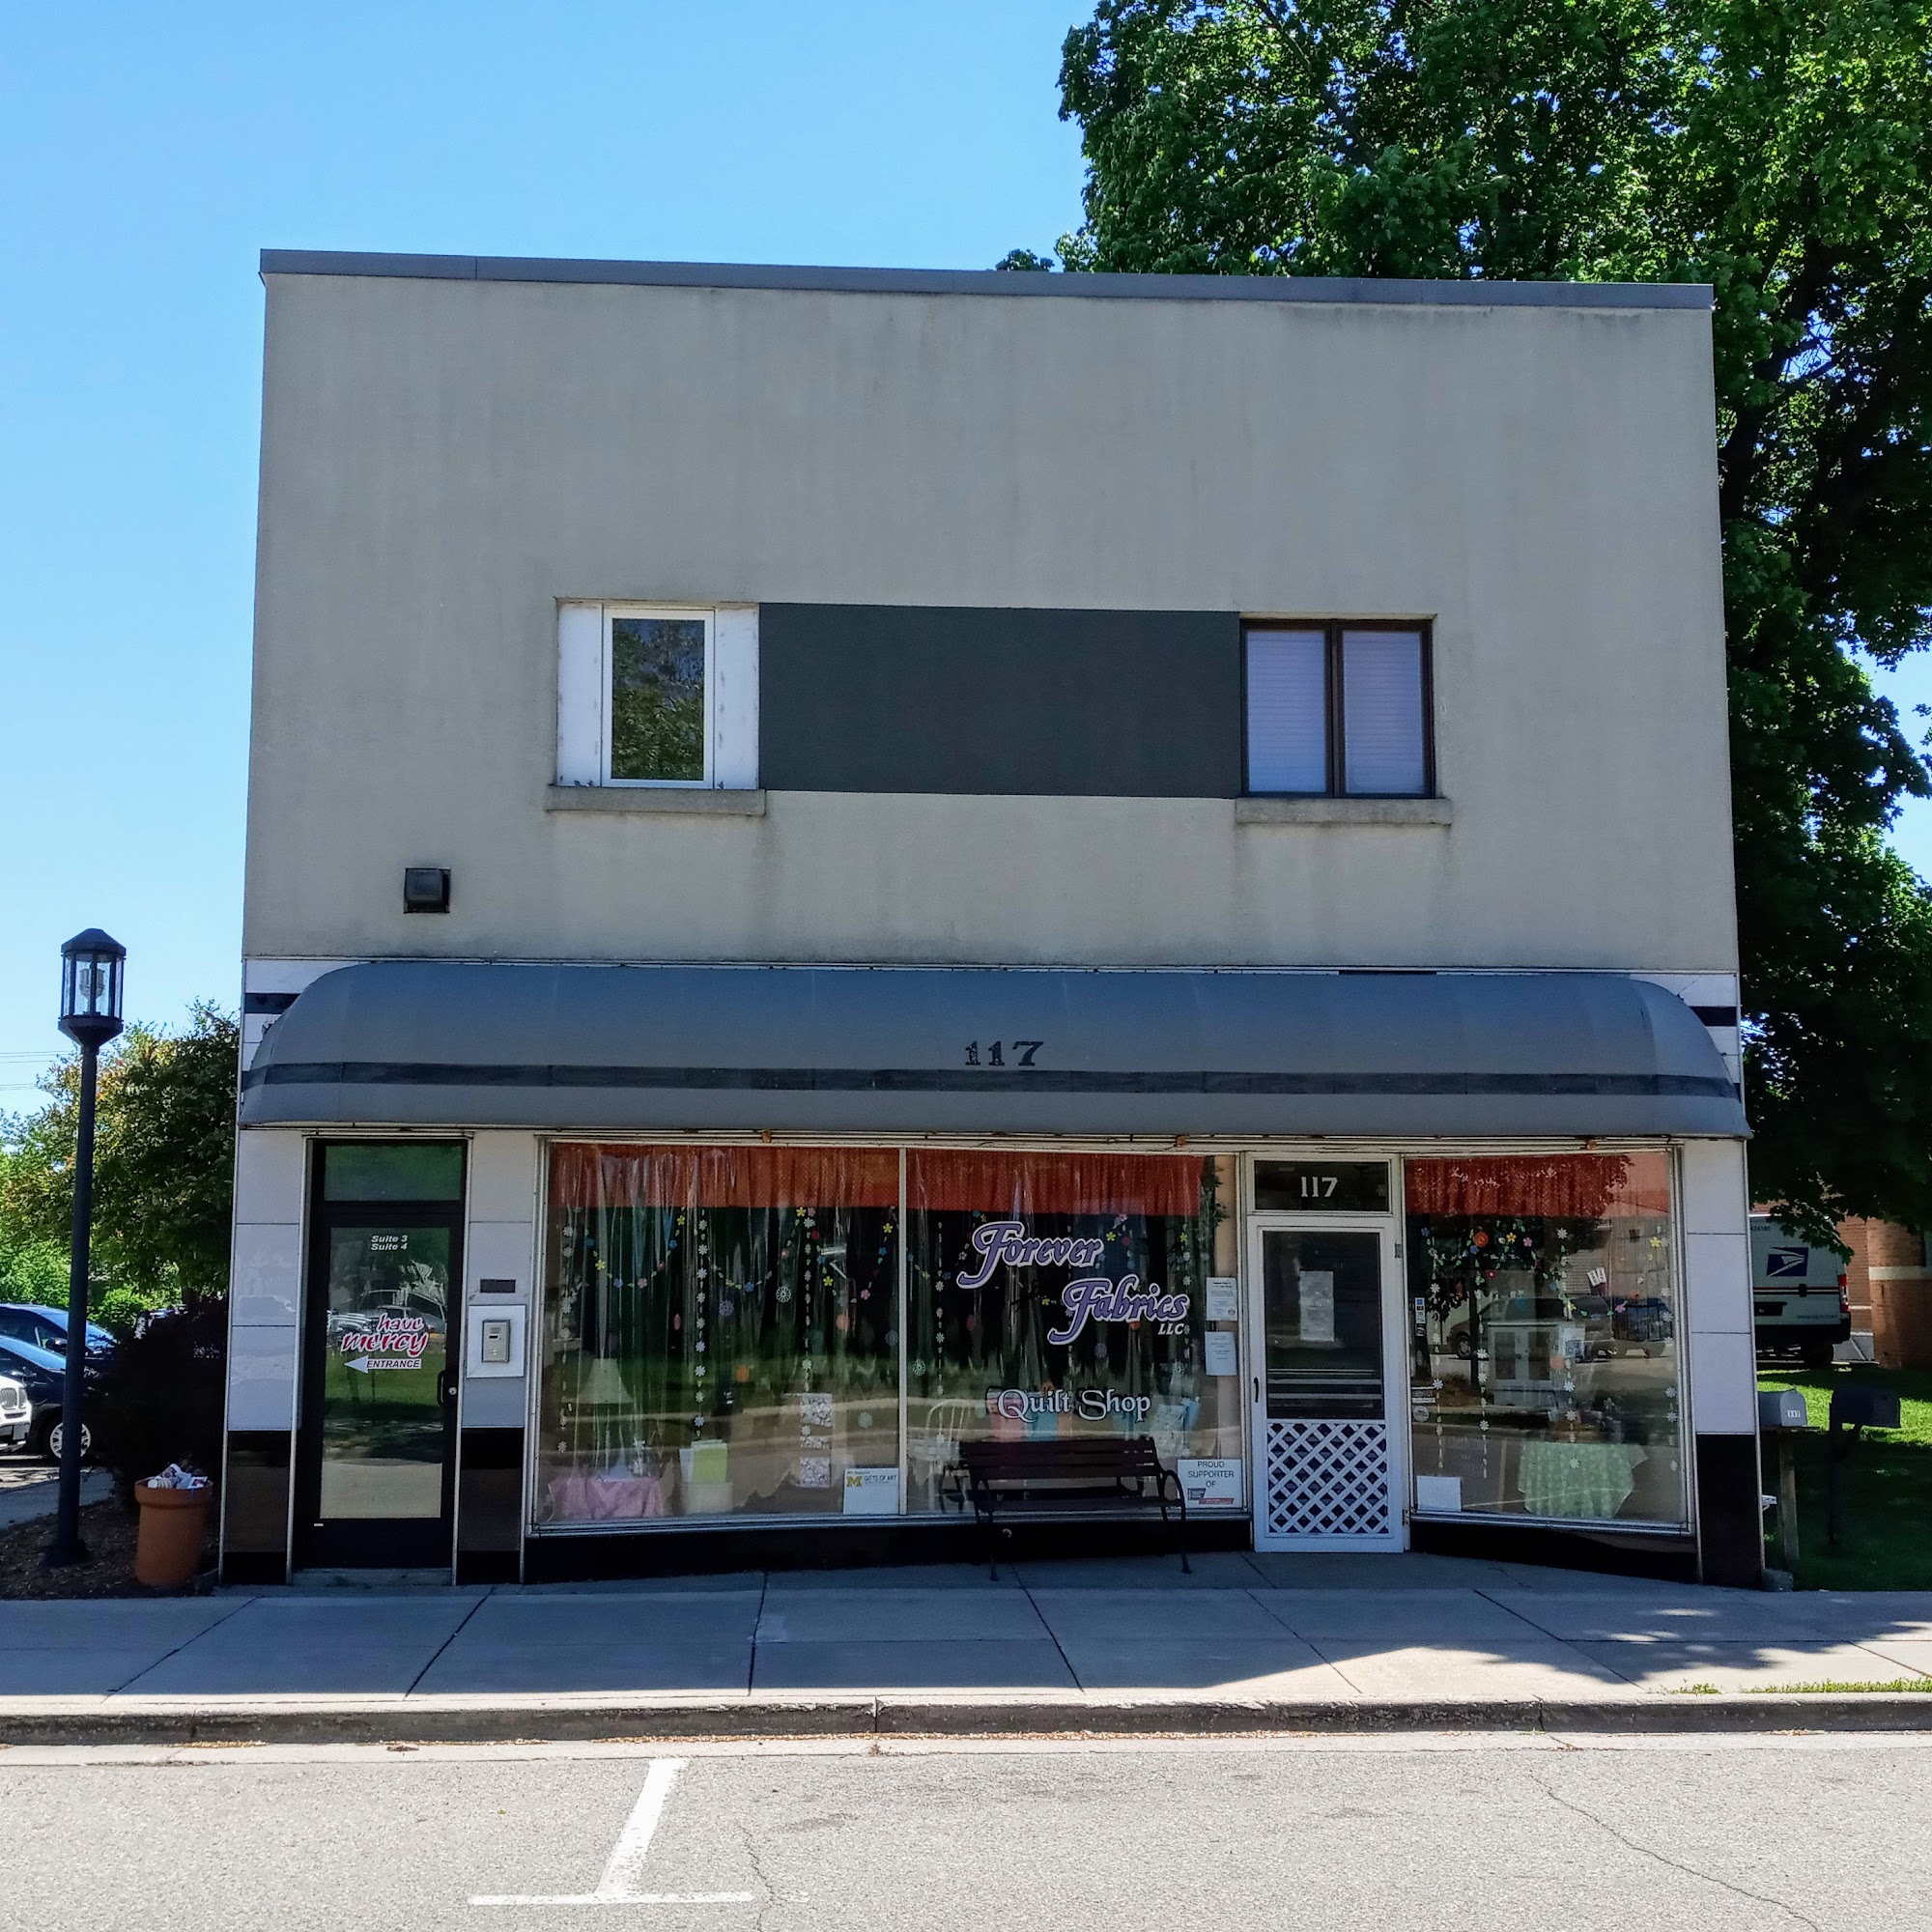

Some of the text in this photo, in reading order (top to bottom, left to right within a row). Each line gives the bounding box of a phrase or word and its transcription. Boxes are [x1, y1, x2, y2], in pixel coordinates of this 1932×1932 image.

[965, 1040, 1044, 1066] 117
[1300, 1176, 1338, 1198] 117
[400, 1242, 408, 1251] 4
[956, 1221, 1103, 1289] Forever
[1047, 1273, 1190, 1345] Fabrics
[378, 1313, 424, 1332] have
[1157, 1322, 1185, 1336] LLC
[341, 1332, 428, 1356] mercy
[997, 1388, 1151, 1423] Quilt Shop
[1206, 1480, 1216, 1489] OF
